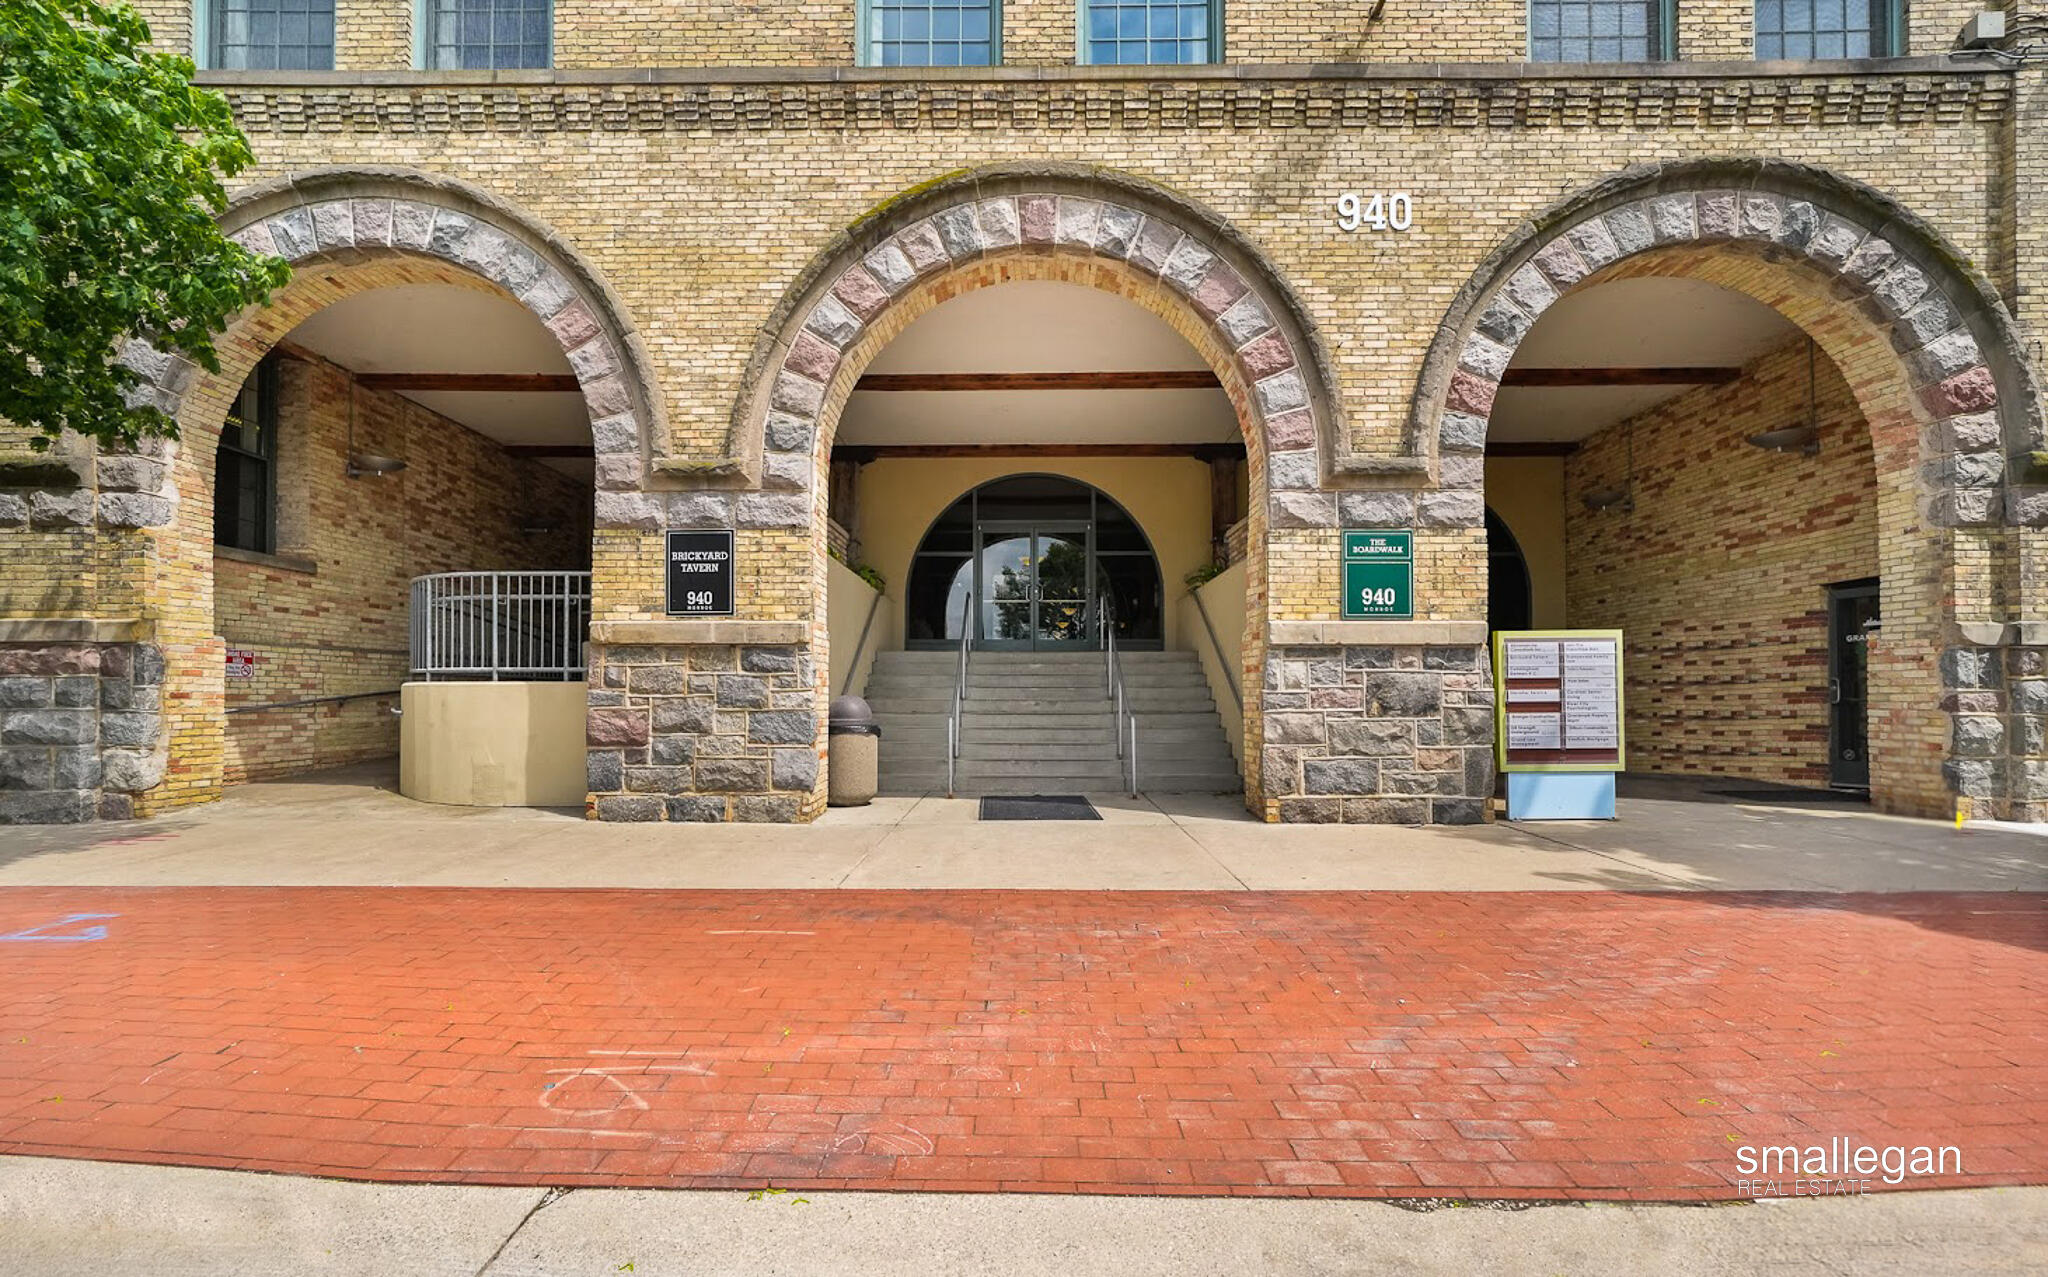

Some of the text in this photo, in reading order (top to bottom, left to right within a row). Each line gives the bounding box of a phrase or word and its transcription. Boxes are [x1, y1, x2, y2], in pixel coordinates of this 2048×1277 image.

[1337, 193, 1412, 231] 940
[671, 551, 728, 561] BRICKYARD
[680, 563, 719, 573] TAVERN
[687, 591, 712, 605] 940
[1361, 587, 1395, 605] 940
